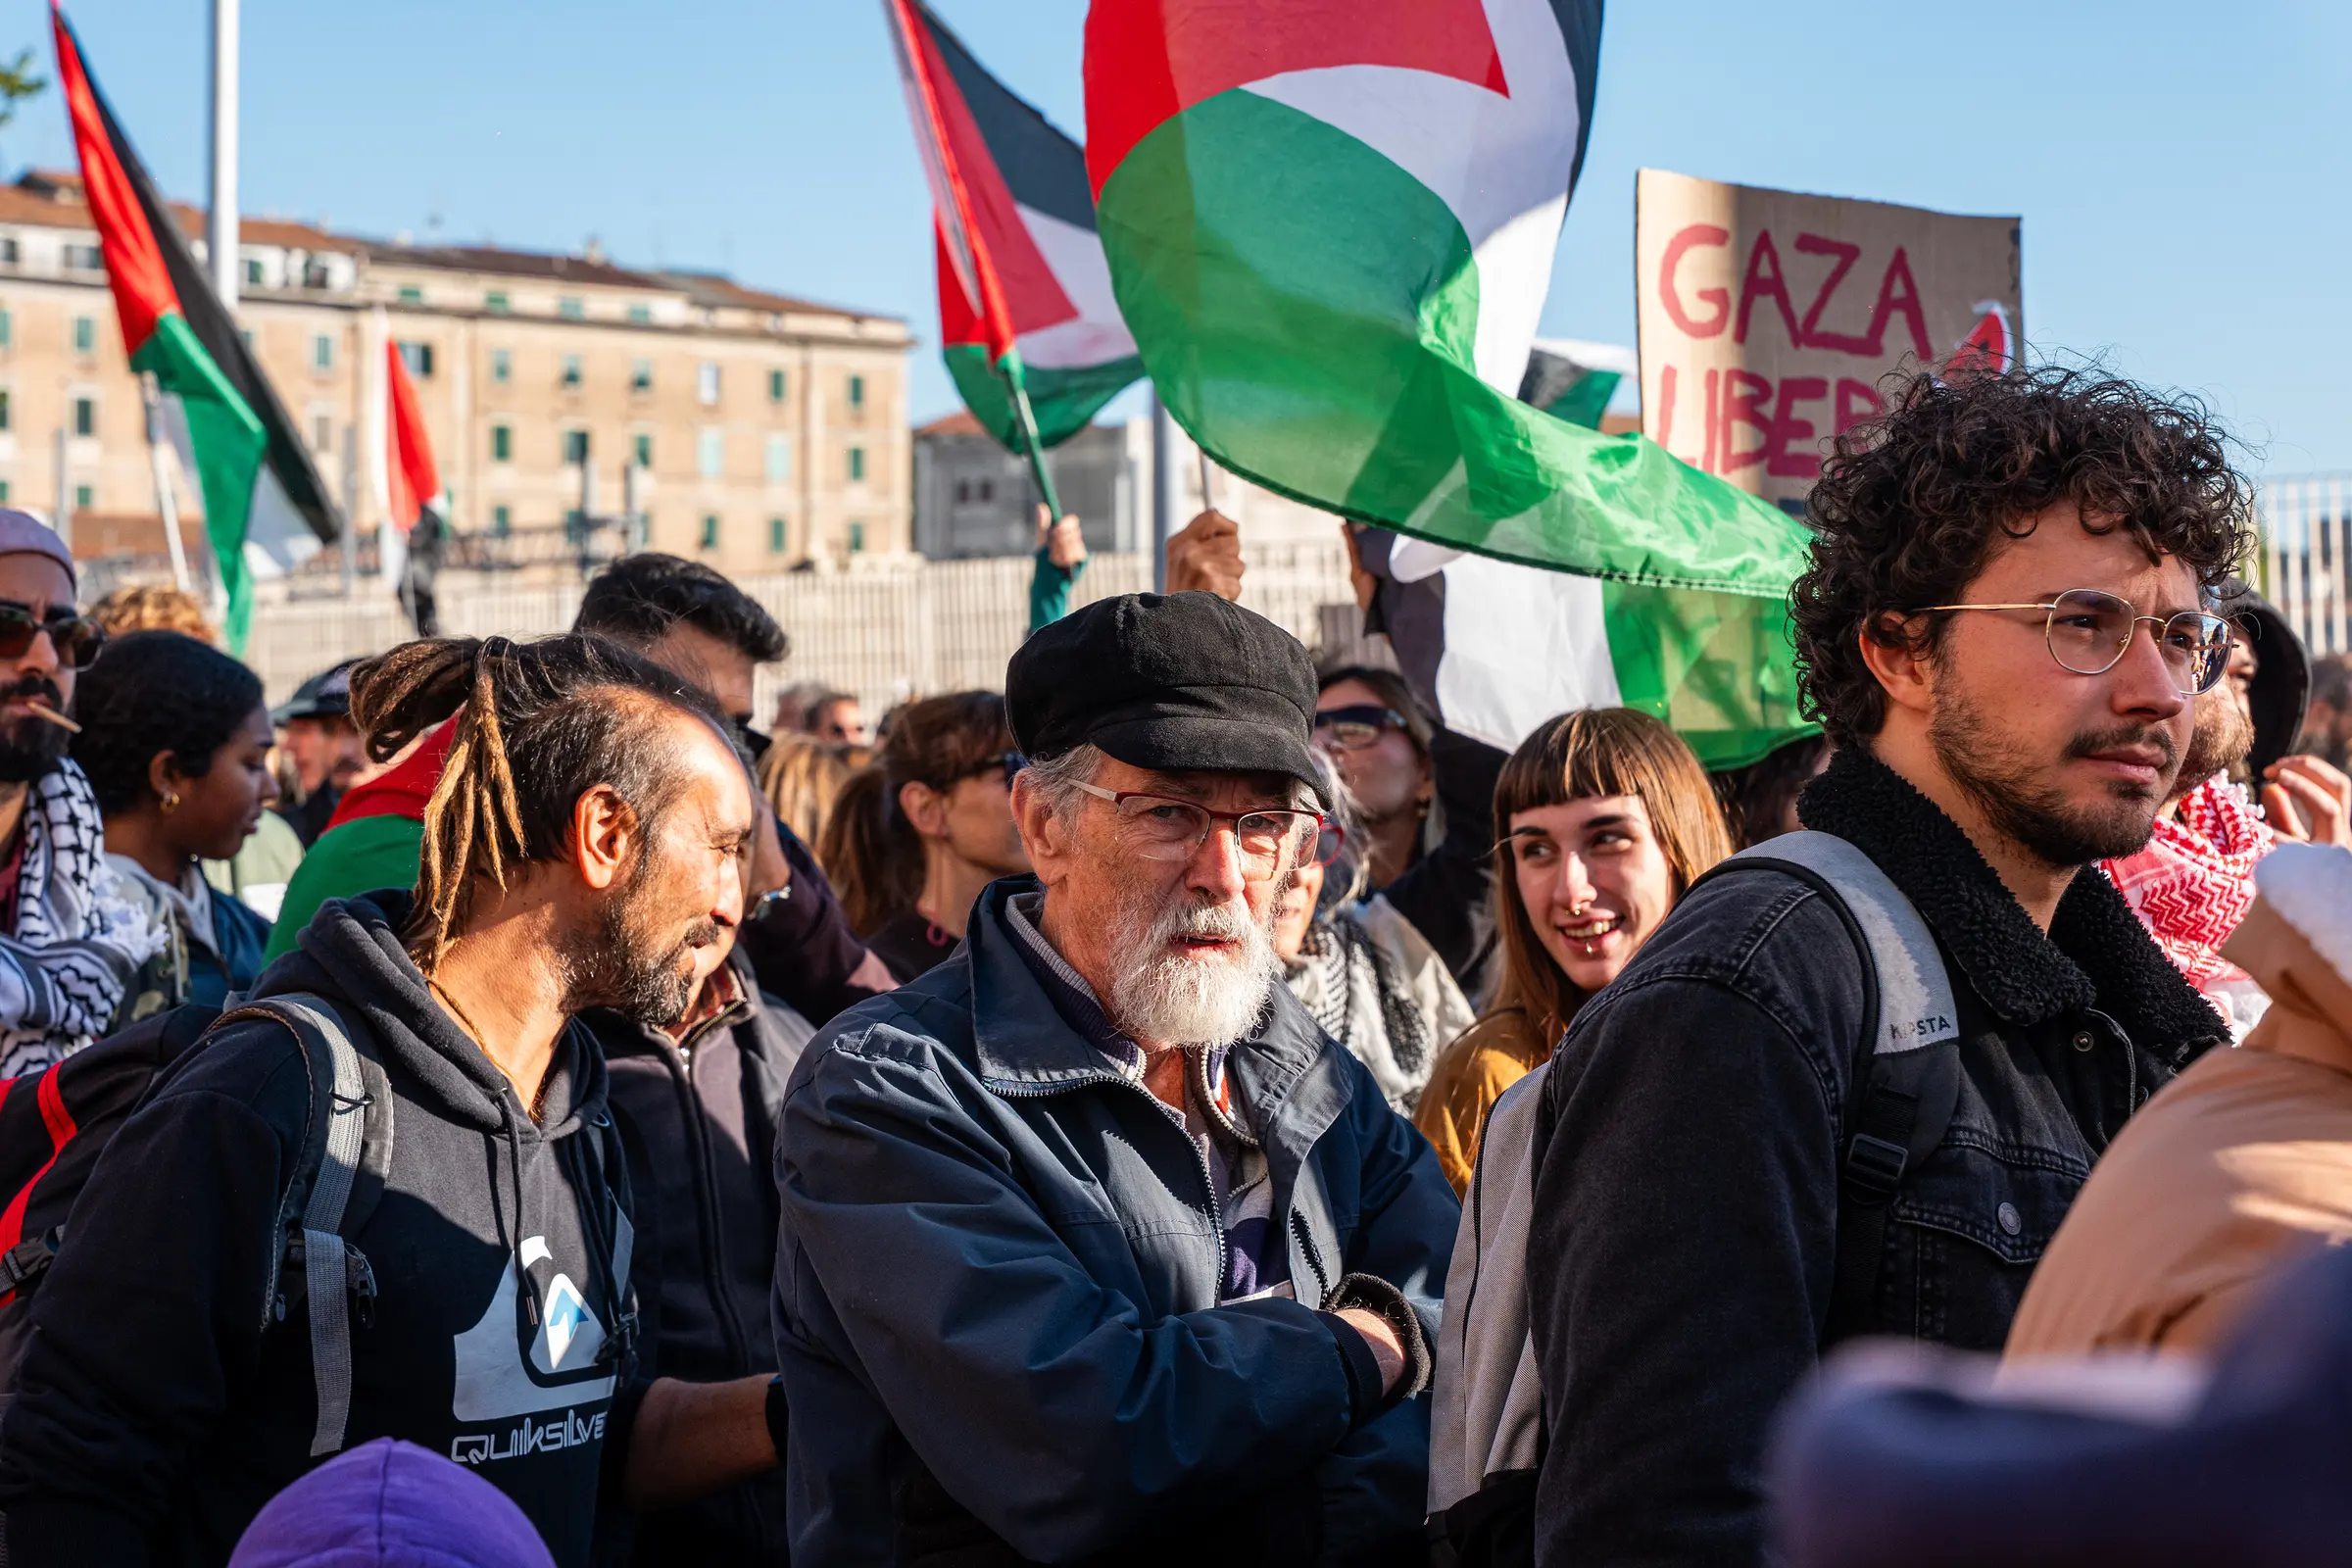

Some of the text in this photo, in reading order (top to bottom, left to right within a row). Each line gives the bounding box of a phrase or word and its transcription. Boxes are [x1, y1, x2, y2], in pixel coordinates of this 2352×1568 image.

[1659, 223, 1933, 362] GAZA
[1656, 365, 1901, 478] LIBER
[1889, 1015, 1951, 1040] KPSTA
